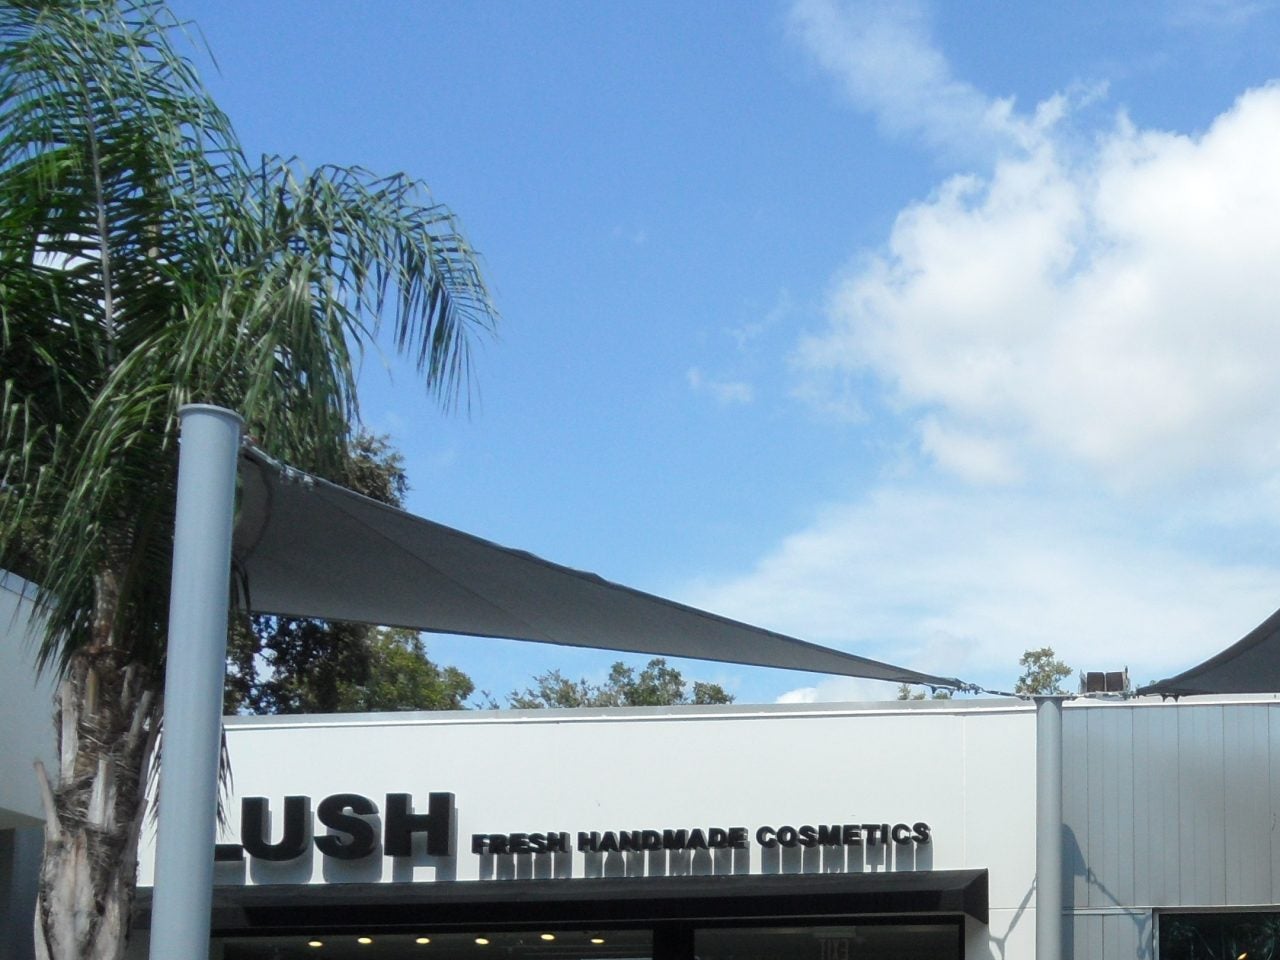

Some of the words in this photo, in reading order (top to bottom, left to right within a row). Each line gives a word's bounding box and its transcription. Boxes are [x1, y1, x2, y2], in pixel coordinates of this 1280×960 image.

[472, 831, 570, 854] FRESH
[578, 826, 750, 852] HANDMADE
[756, 822, 931, 849] COSMETICS
